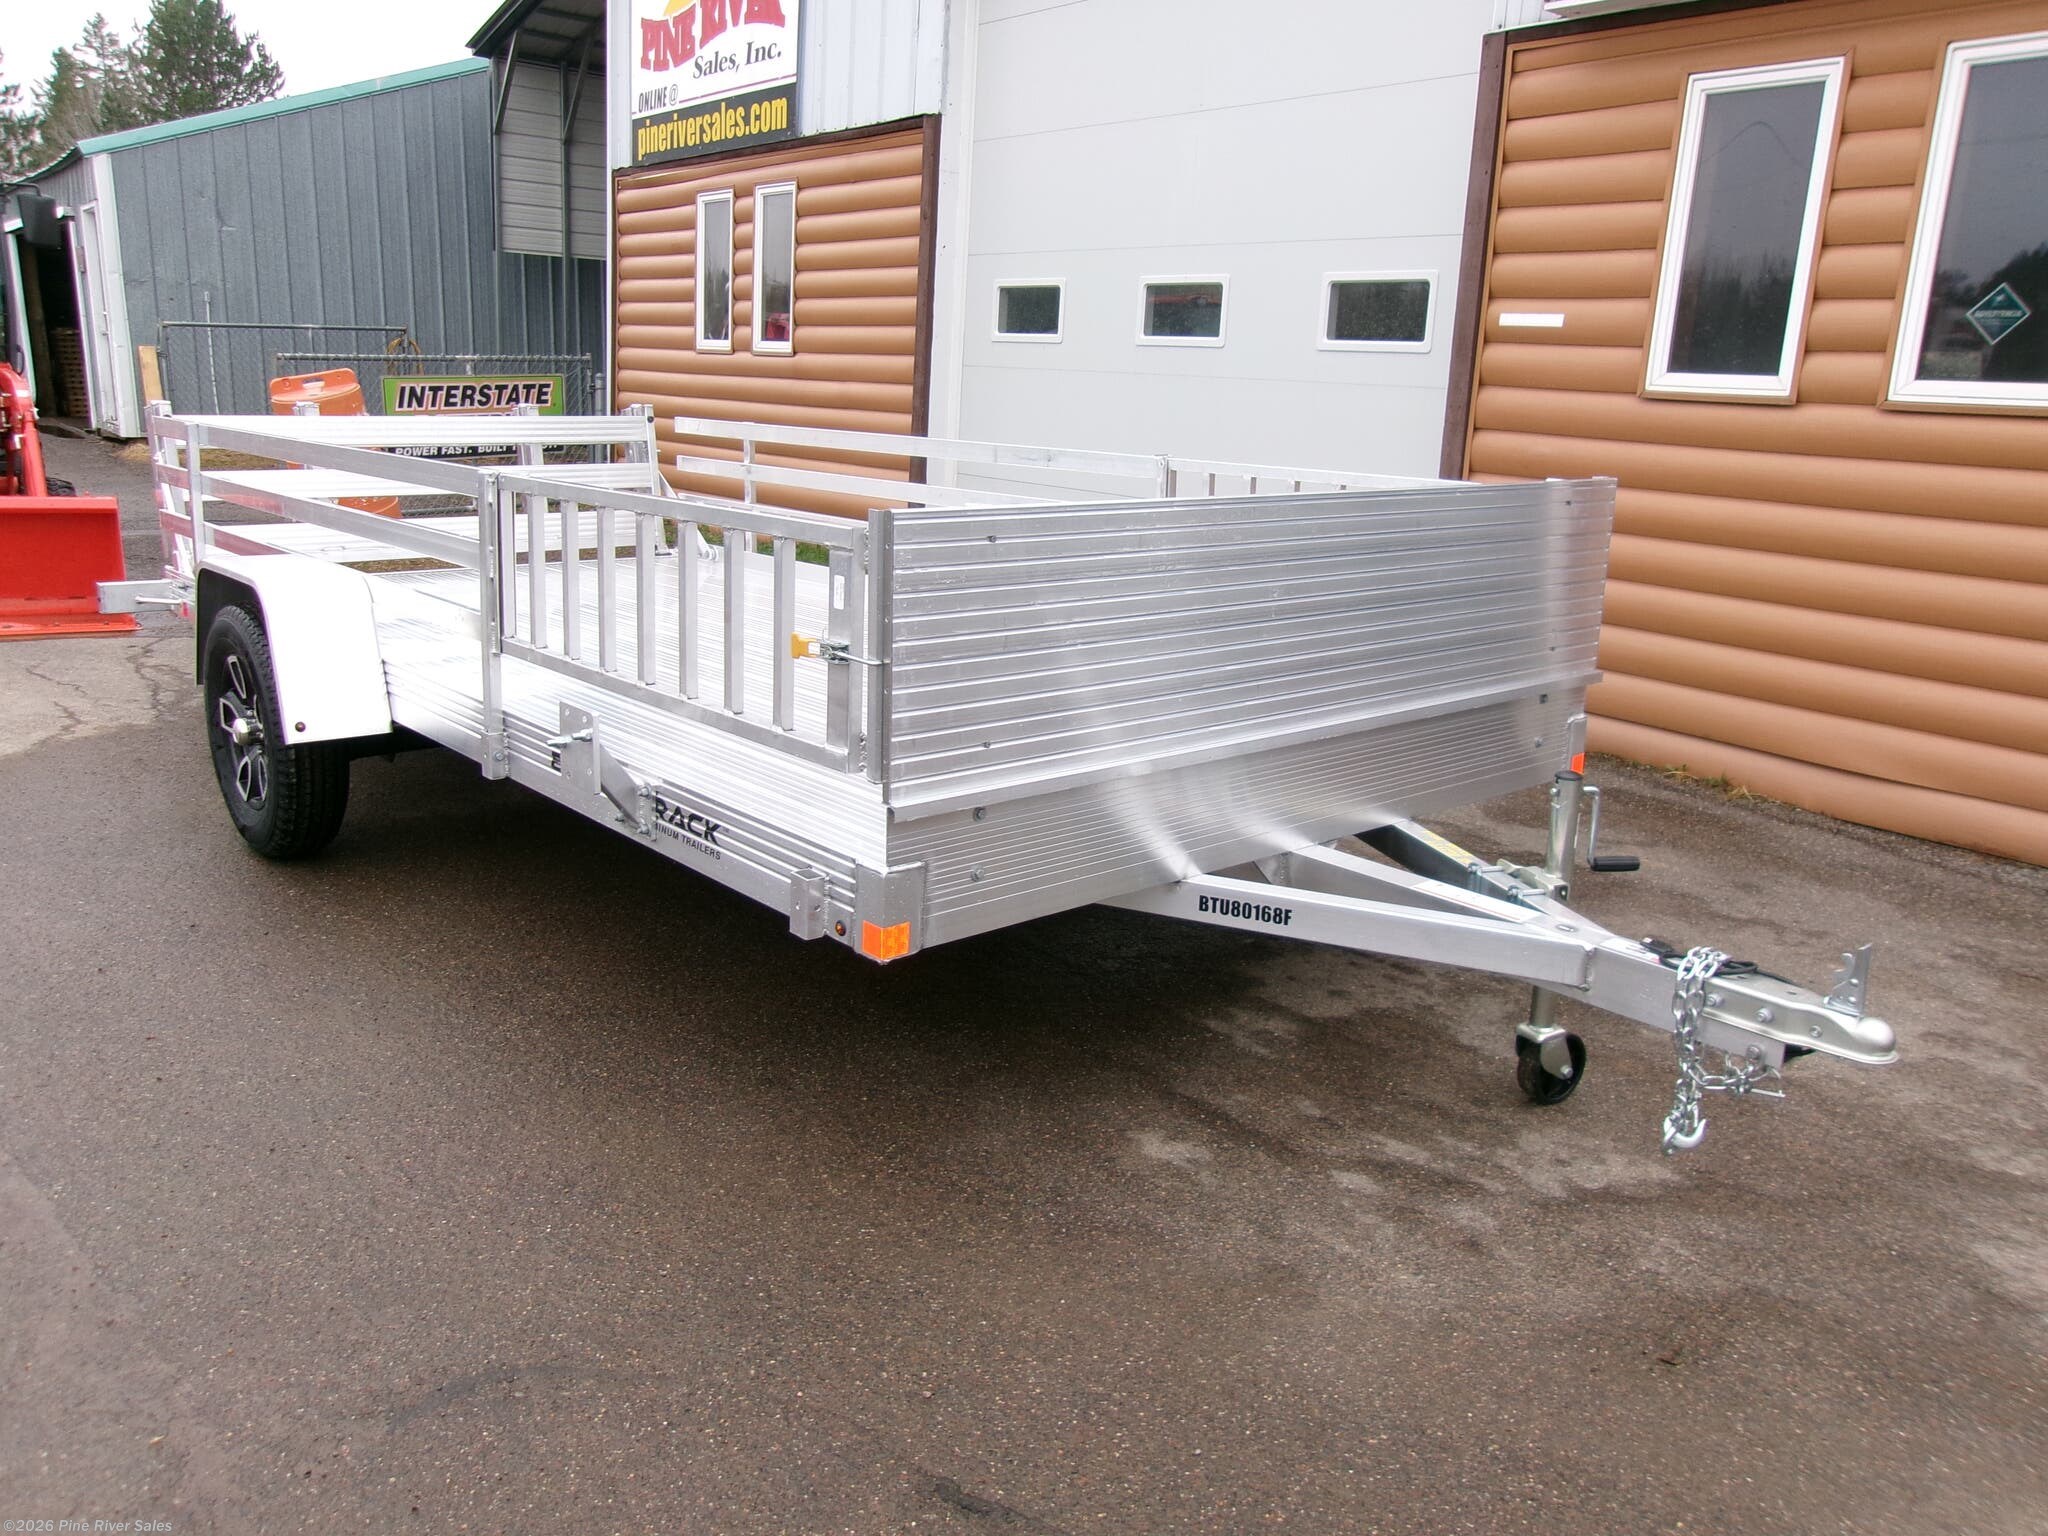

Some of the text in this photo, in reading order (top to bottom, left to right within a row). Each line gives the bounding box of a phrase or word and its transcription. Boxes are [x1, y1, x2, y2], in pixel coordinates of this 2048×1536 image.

[640, 2, 696, 72] PINE
[693, 41, 782, 79] Sales, Inc.
[638, 84, 679, 114] ONLINE @
[637, 97, 788, 161] pineriversales.com
[396, 381, 552, 410] INTERSTATE
[395, 446, 437, 457] POWER
[441, 445, 472, 455] FAST.
[655, 791, 720, 848] RACK
[655, 823, 721, 860] INUM TRAILERS
[1198, 894, 1293, 926] BTU80168F
